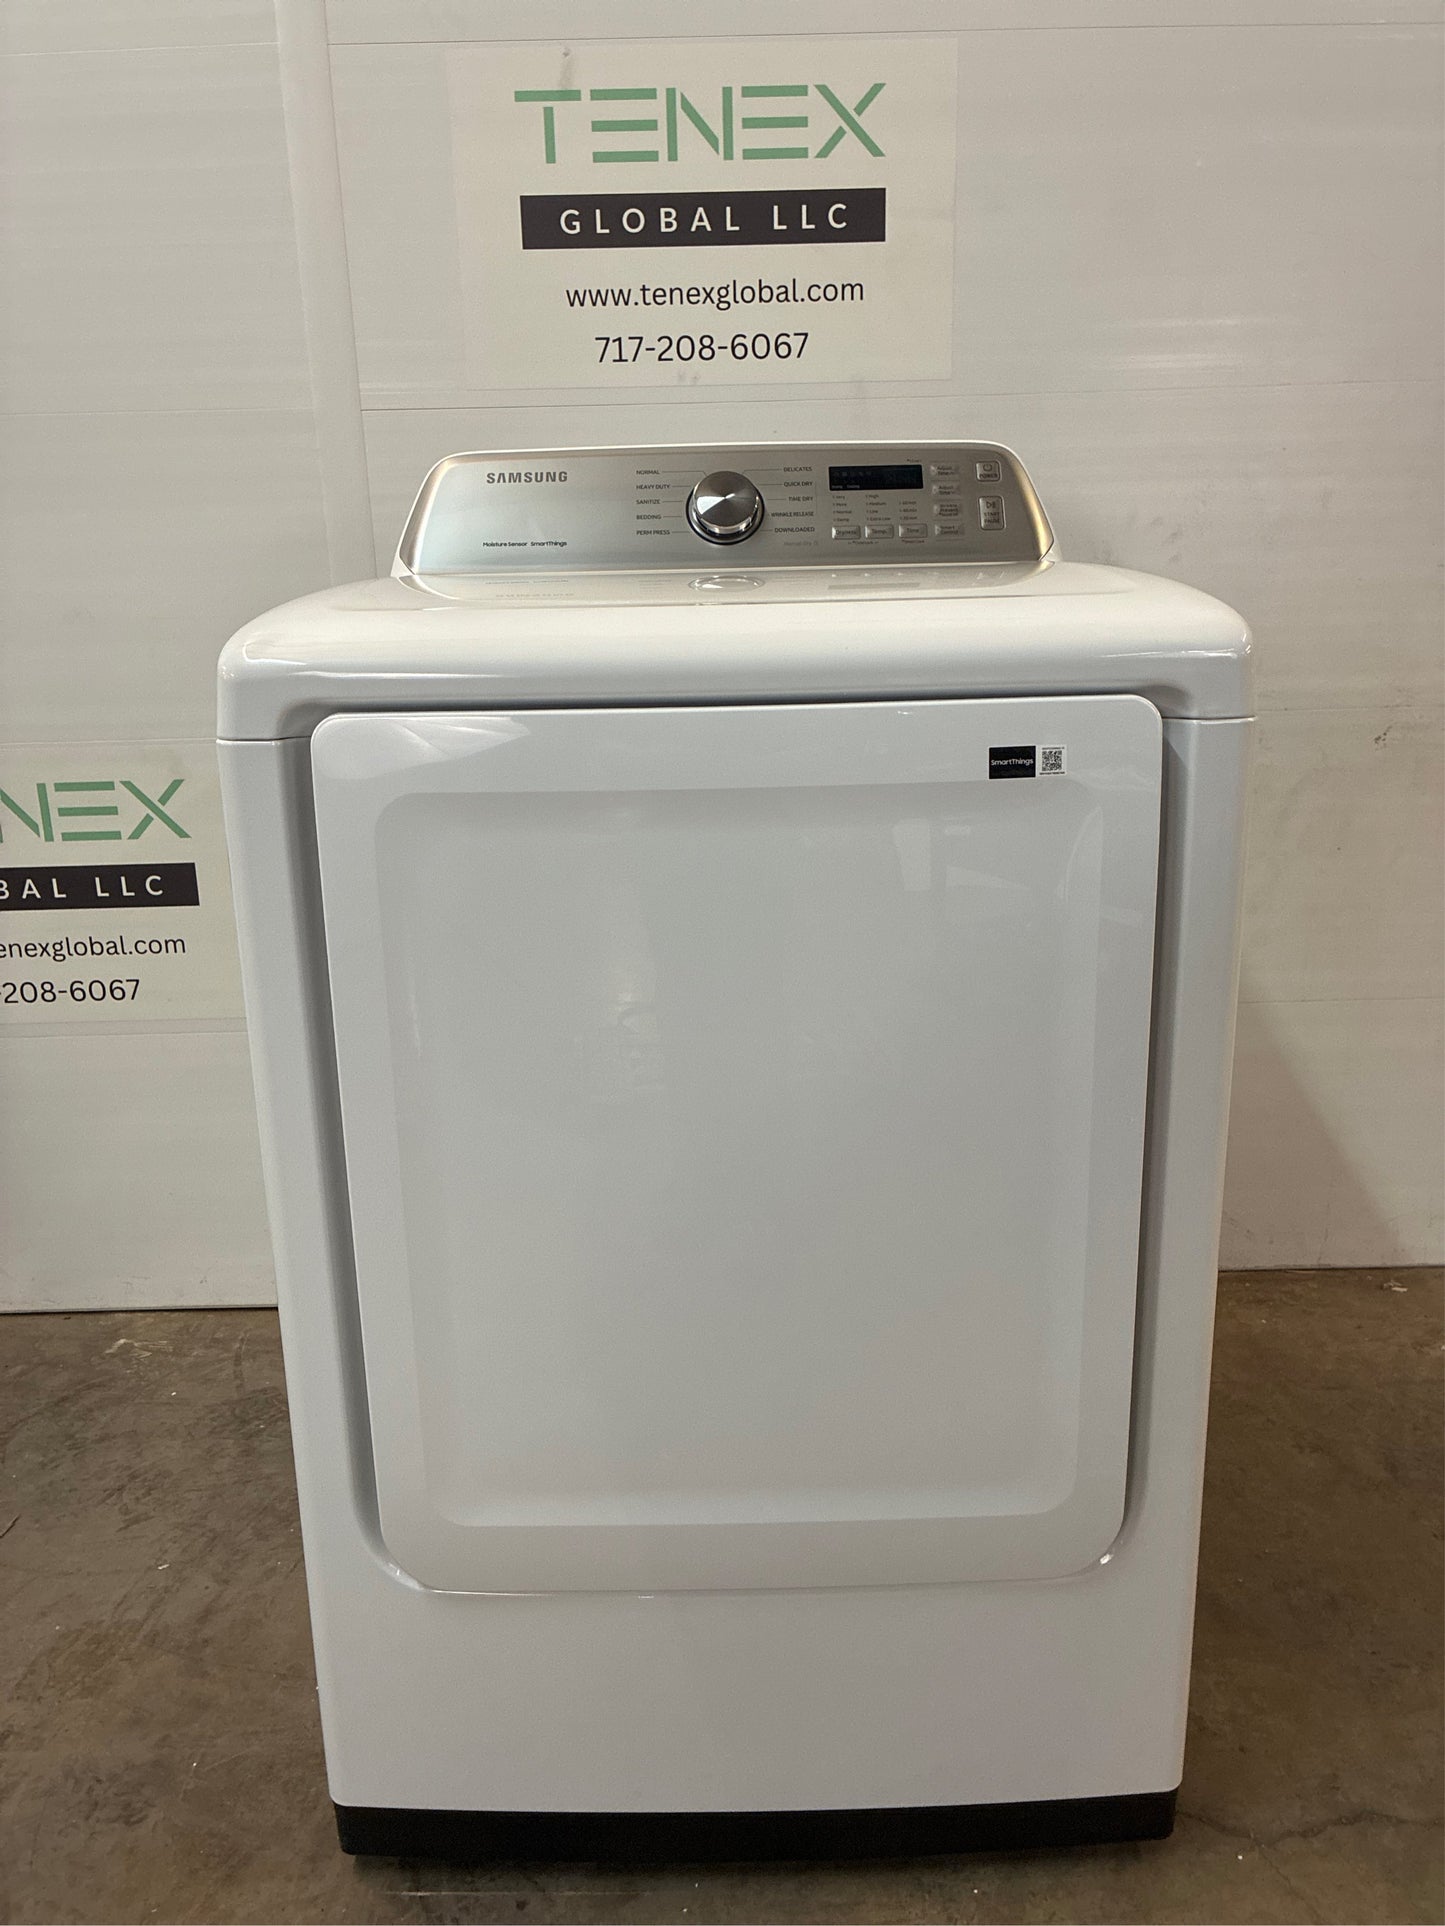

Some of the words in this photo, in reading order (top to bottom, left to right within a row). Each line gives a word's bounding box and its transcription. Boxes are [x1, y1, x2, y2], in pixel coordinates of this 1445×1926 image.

[514, 83, 887, 164] TENEX
[559, 205, 740, 235] GLOBAL
[772, 203, 849, 230] LLC
[566, 279, 864, 310] www.tenexglobal.com
[594, 332, 810, 363] 717-208-6067
[486, 471, 569, 484] SAMSUNG
[530, 540, 568, 548] SmartThings
[991, 758, 1034, 766] SmartThings
[95, 875, 164, 897] LLC
[0, 979, 140, 1004] 208-6067
